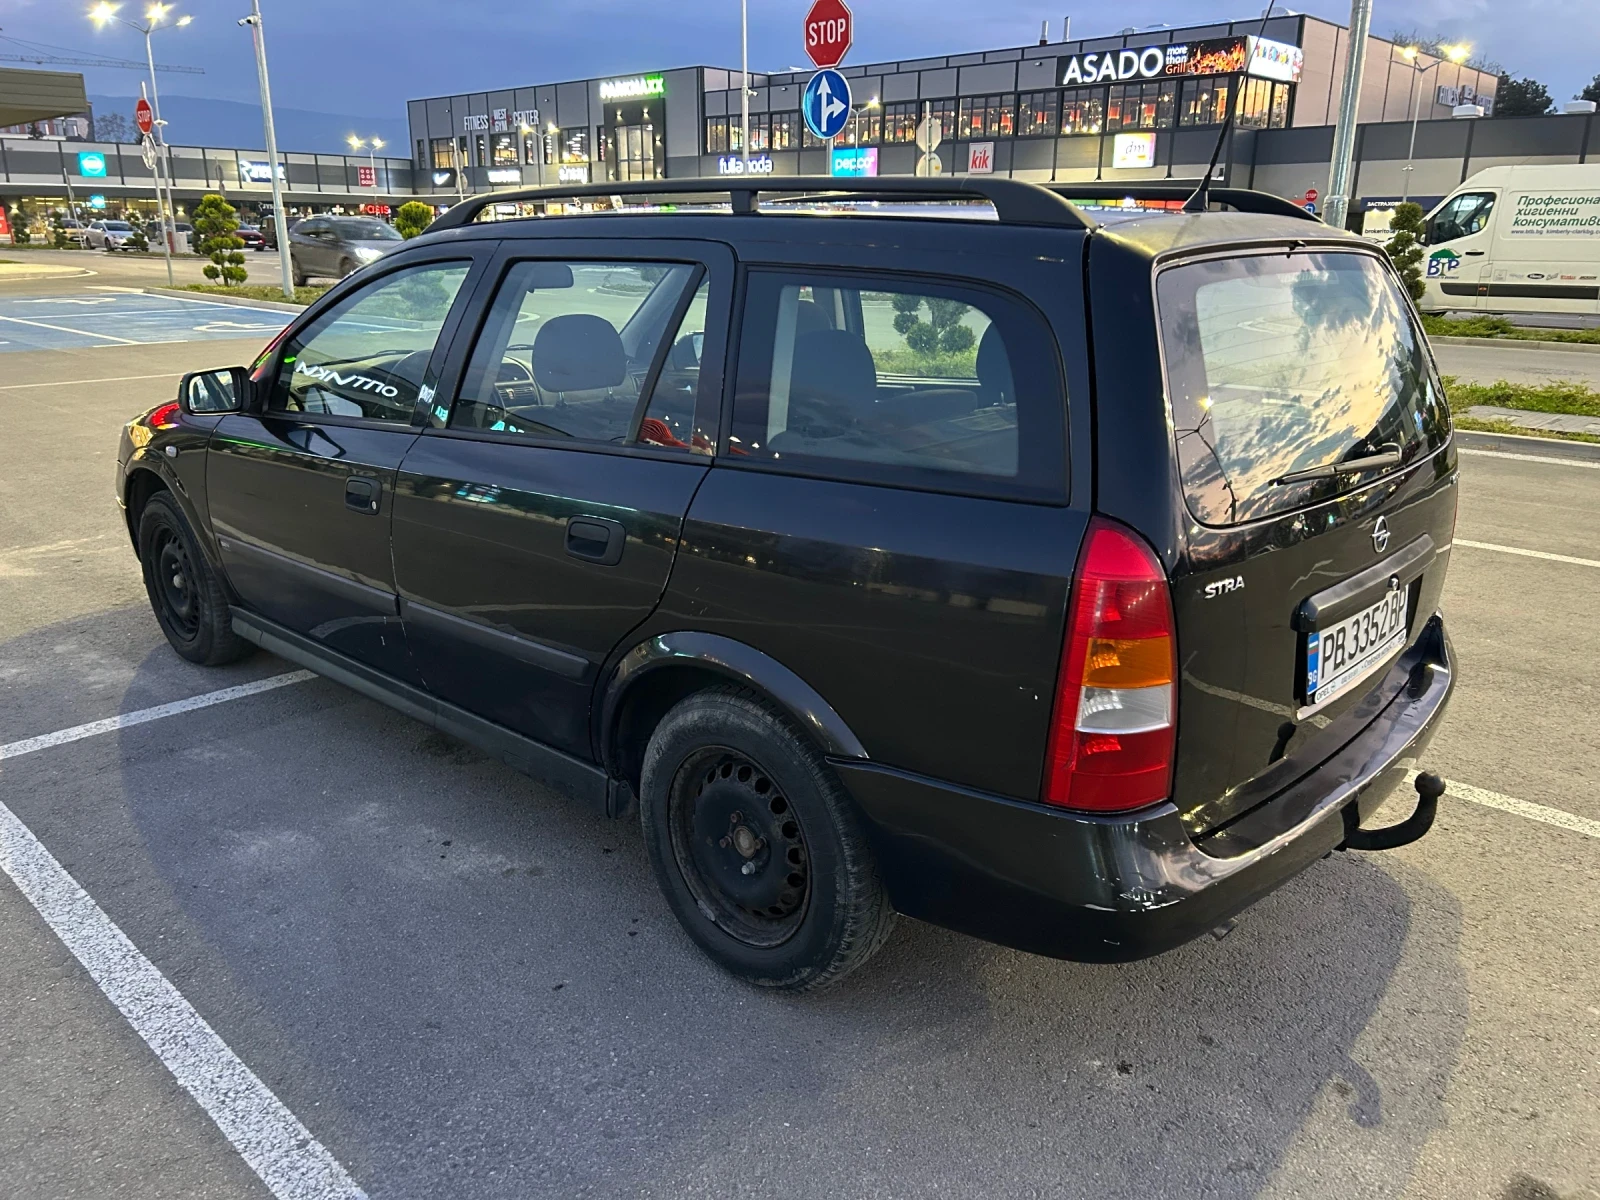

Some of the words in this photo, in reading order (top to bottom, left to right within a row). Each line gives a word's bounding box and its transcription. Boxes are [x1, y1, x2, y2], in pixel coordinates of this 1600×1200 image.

[809, 18, 846, 46] STOP
[1167, 45, 1188, 55] more
[1063, 47, 1164, 85] ASADO
[1166, 55, 1187, 65] than
[1165, 63, 1186, 75] Grill
[137, 110, 151, 123] STOP
[463, 115, 489, 131] FITNESS
[513, 109, 540, 126] CENTER
[493, 108, 507, 120] WEST
[495, 120, 508, 132] GYM
[1125, 141, 1145, 154] dm
[719, 157, 743, 174] fulla
[834, 157, 872, 172] pepco
[971, 149, 990, 169] kik
[1517, 195, 1600, 208] Професиона
[1515, 207, 1579, 216] хигиенни
[1204, 575, 1245, 599] STRA
[1316, 688, 1330, 702] OPEL
